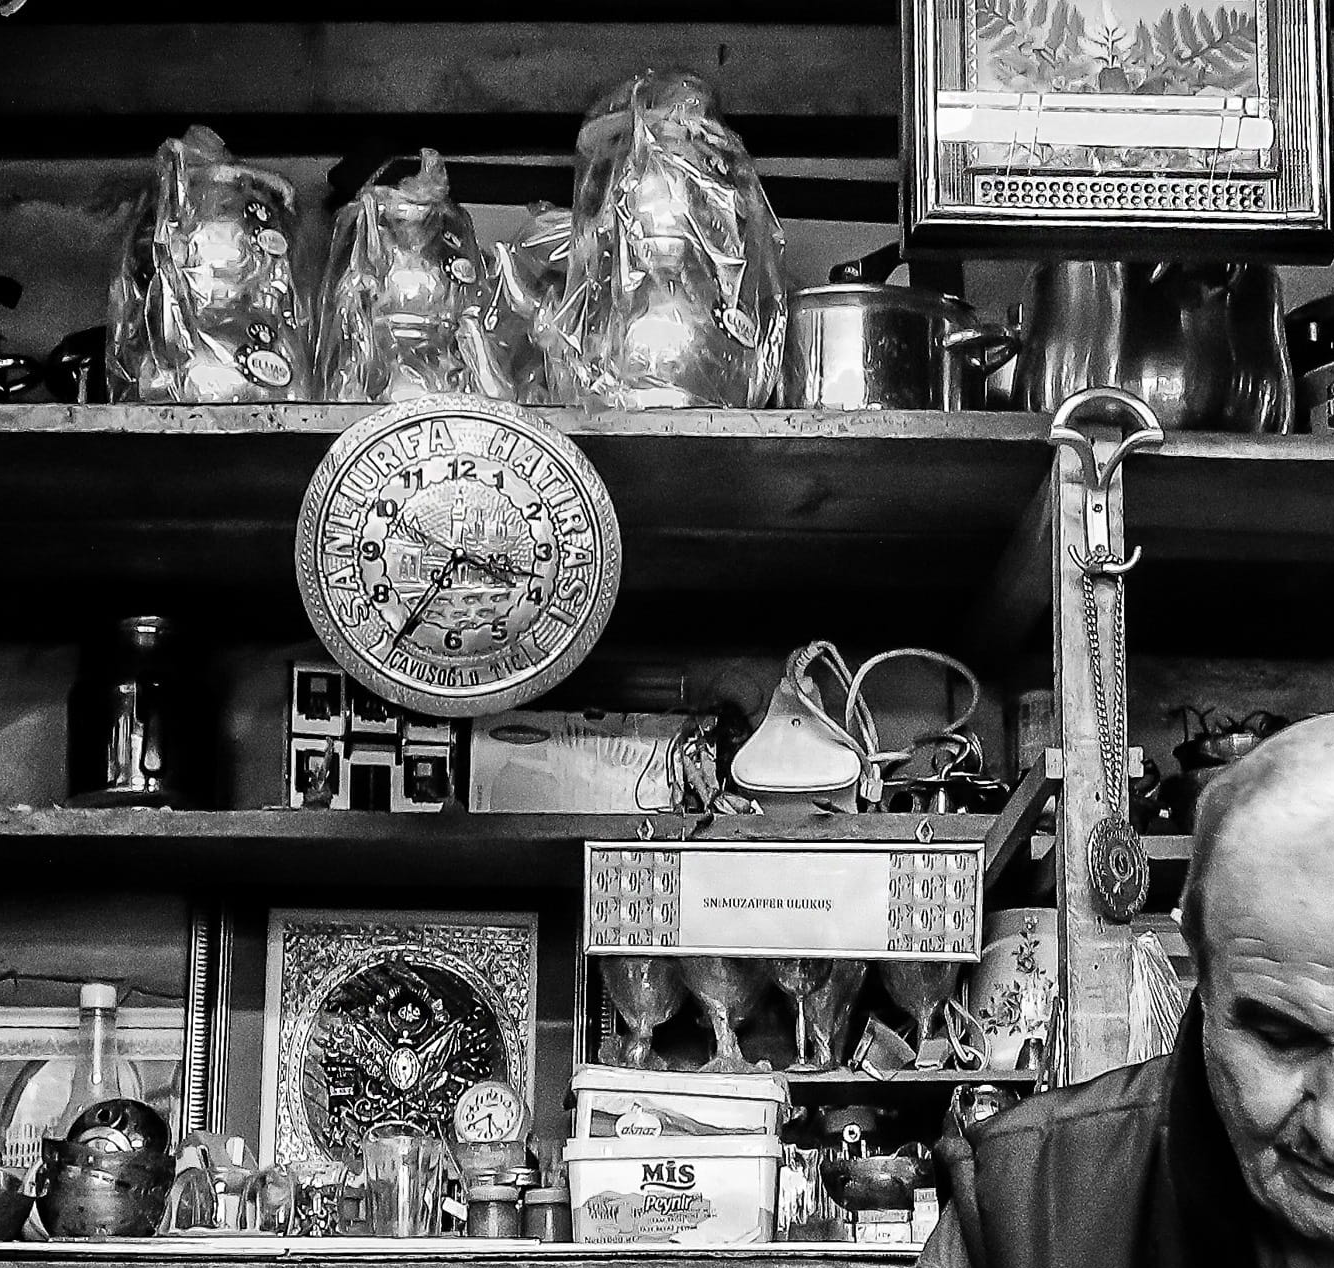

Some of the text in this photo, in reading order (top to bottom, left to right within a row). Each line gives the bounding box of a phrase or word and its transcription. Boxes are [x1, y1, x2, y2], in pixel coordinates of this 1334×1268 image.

[401, 467, 424, 489] 11
[447, 459, 477, 480] 12
[493, 470, 504, 489] 1
[374, 499, 398, 518] 10
[526, 502, 542, 522] 2
[362, 541, 381, 561] 9
[537, 543, 553, 561] 3
[373, 584, 389, 603] 8
[528, 587, 541, 606] 4
[444, 630, 463, 651] 6
[492, 621, 508, 641] 5
